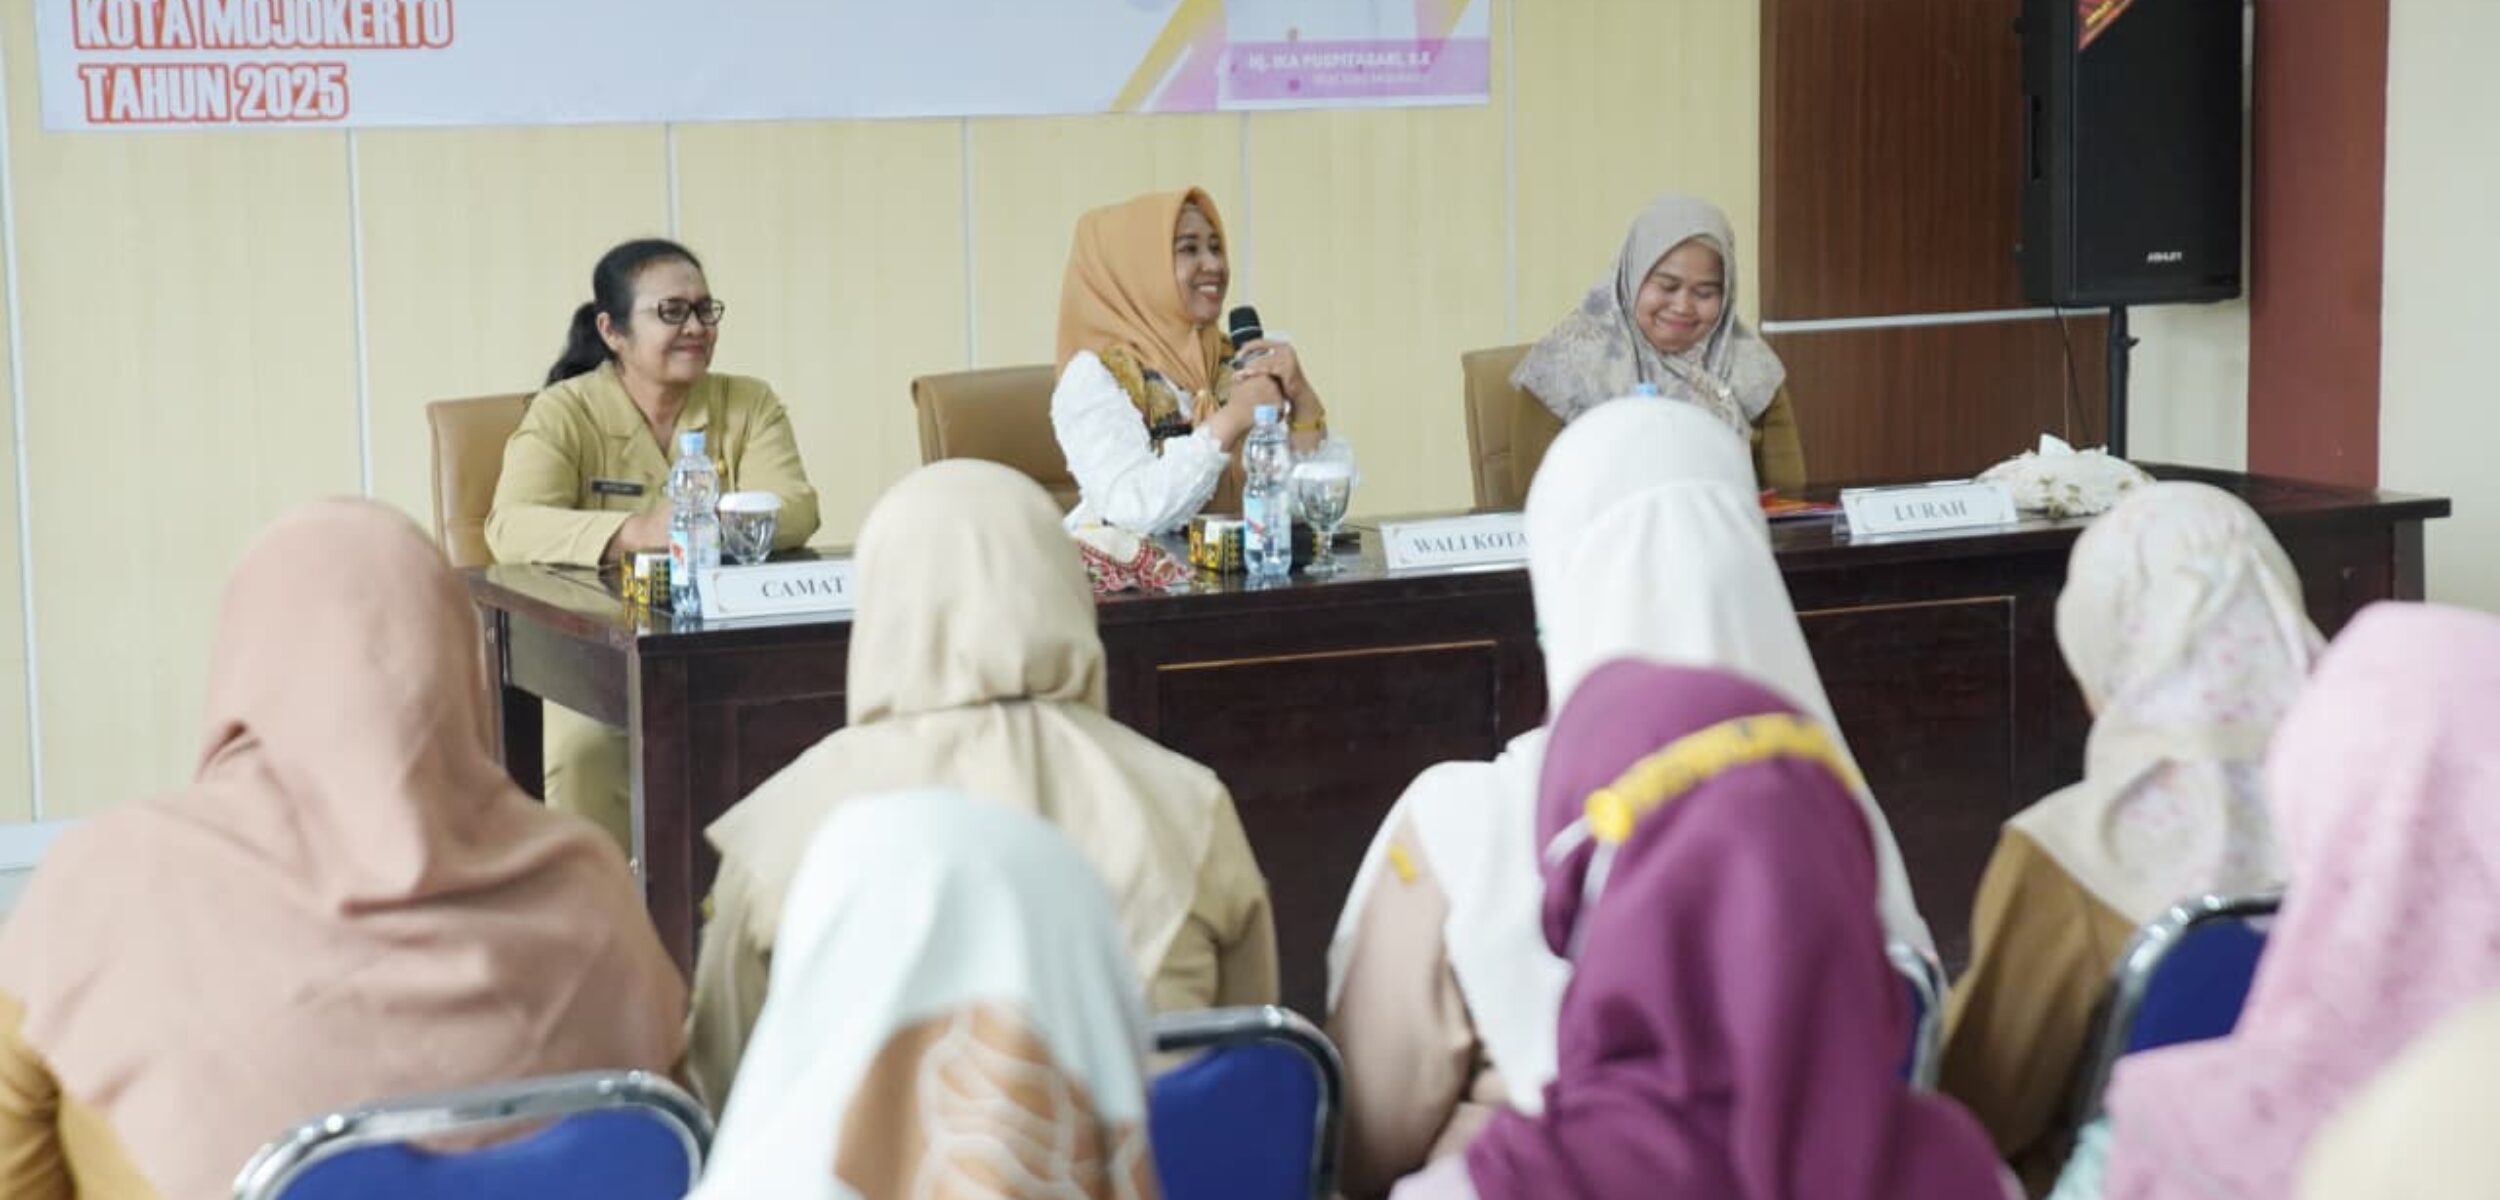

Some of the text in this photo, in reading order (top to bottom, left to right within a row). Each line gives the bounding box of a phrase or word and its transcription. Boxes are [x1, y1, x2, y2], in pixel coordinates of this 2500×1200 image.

[73, 0, 454, 49] KOTA MOJOKERTO
[79, 62, 349, 122] TAHUN 2025
[1893, 500, 1967, 521] LURAH
[1413, 531, 1529, 553] WALI KOTA
[761, 576, 845, 599] CAMAT
